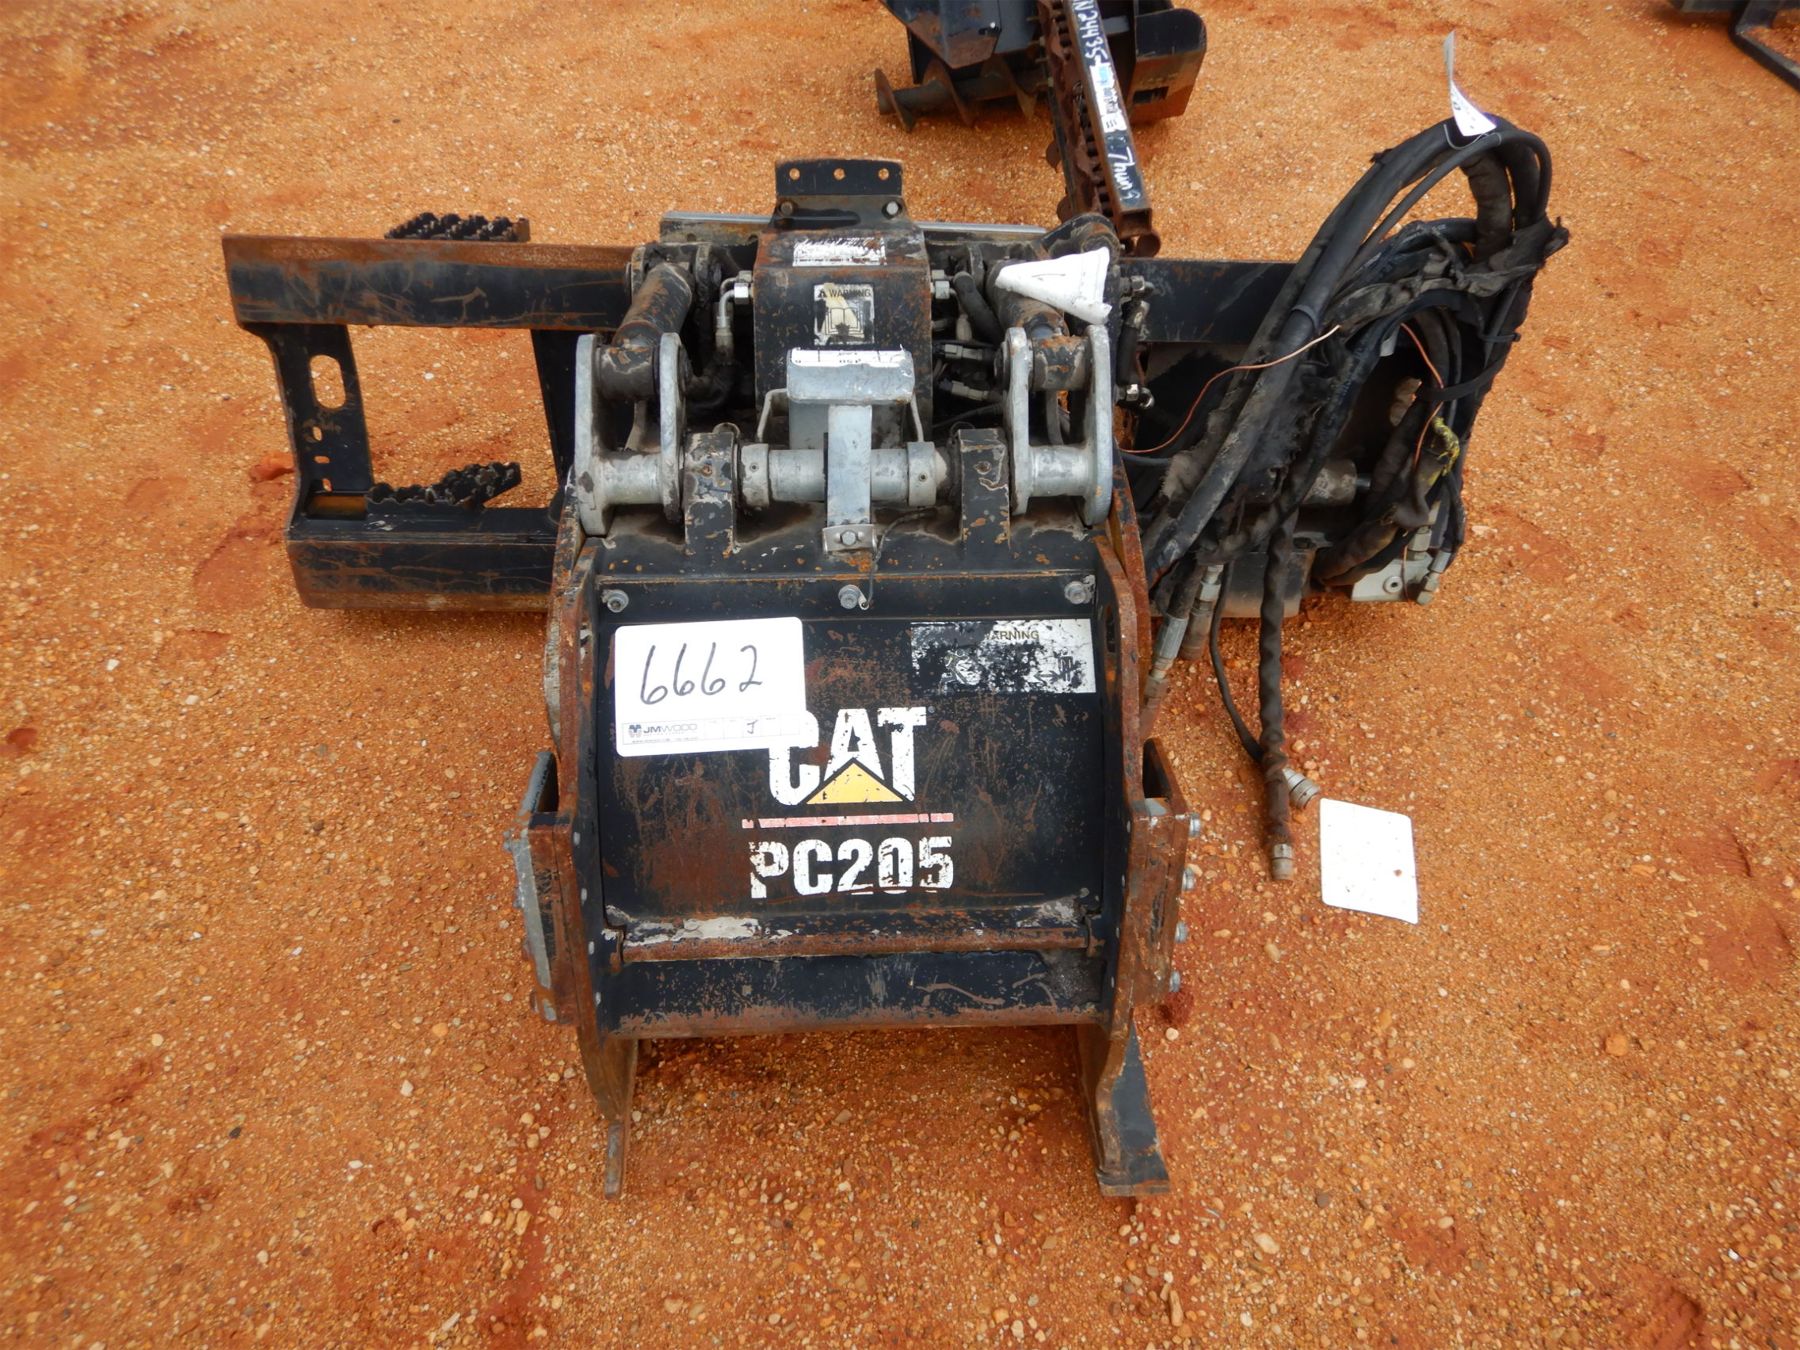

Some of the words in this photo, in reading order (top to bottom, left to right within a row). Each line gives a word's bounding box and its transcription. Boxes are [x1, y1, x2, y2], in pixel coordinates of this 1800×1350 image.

[640, 642, 763, 705] 6662
[769, 706, 927, 806] CAT
[749, 836, 954, 898] PC205
